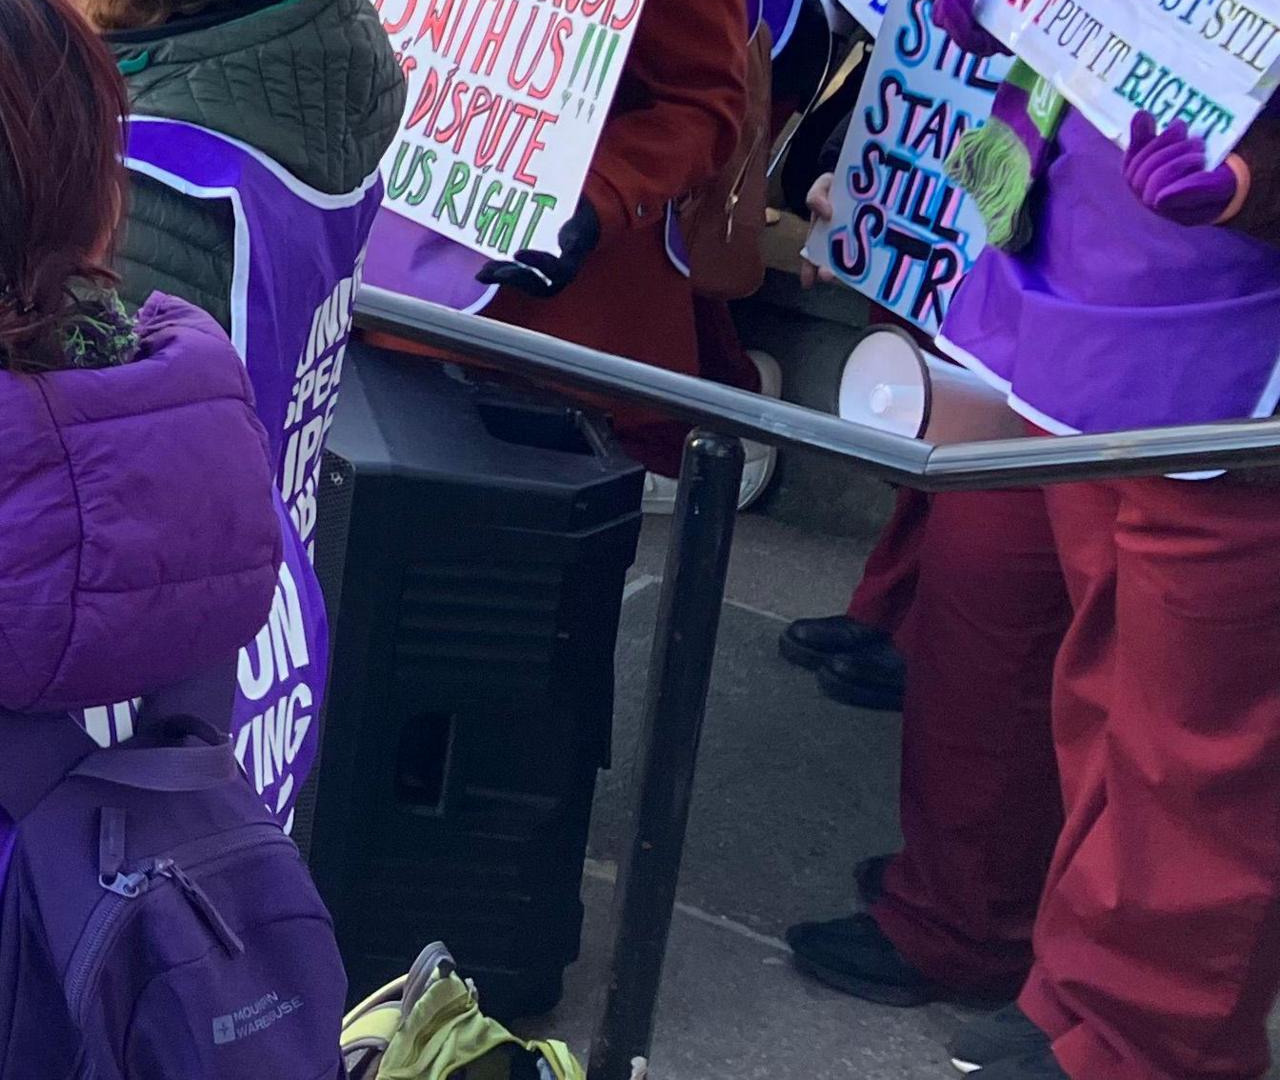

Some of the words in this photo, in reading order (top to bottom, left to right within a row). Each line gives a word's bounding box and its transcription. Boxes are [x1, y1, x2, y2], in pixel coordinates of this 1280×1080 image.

[506, 5, 574, 100] US
[1085, 31, 1132, 83] IT
[1112, 50, 1236, 141] RIGHT
[405, 65, 561, 189] DISPUTE
[386, 140, 438, 208] US
[432, 162, 558, 256] RIGHT
[848, 139, 970, 244] STILL
